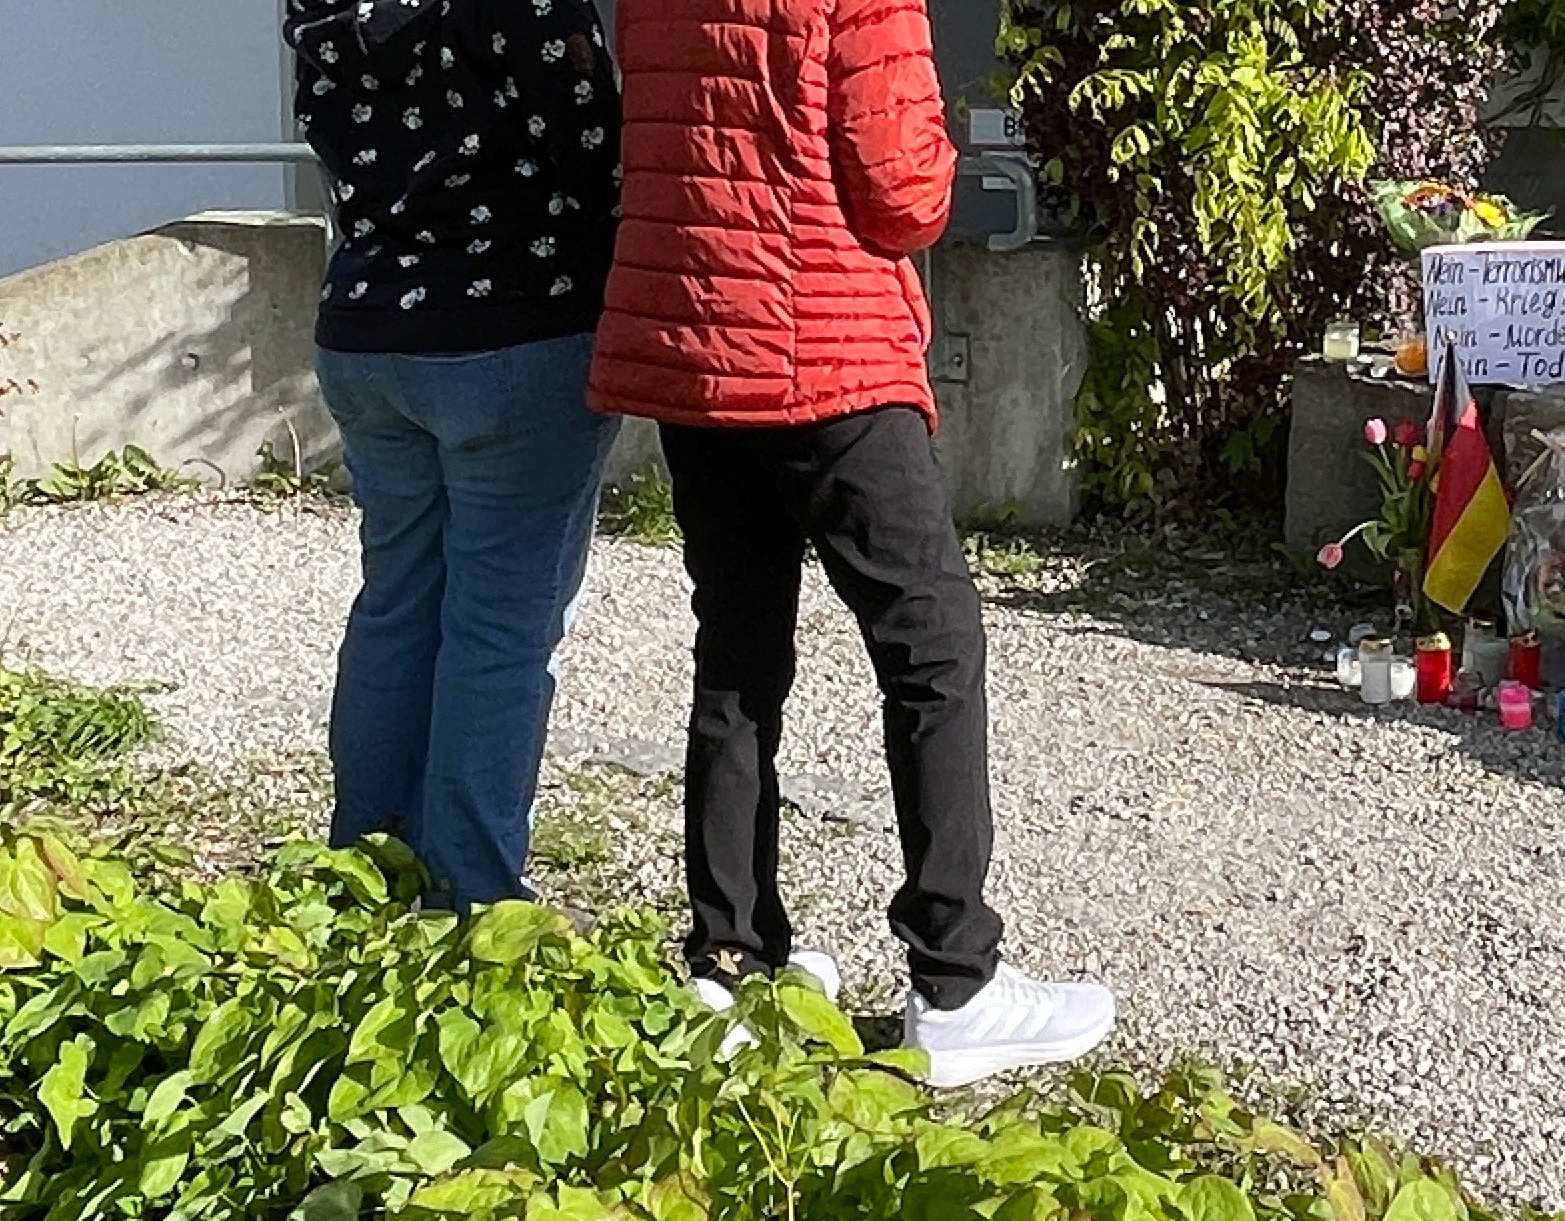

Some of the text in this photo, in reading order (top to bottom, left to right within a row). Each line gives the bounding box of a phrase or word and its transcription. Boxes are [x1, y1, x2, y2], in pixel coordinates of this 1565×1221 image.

[1427, 252, 1464, 285] Nein
[1427, 288, 1467, 317] Nein
[1436, 354, 1488, 379] in
